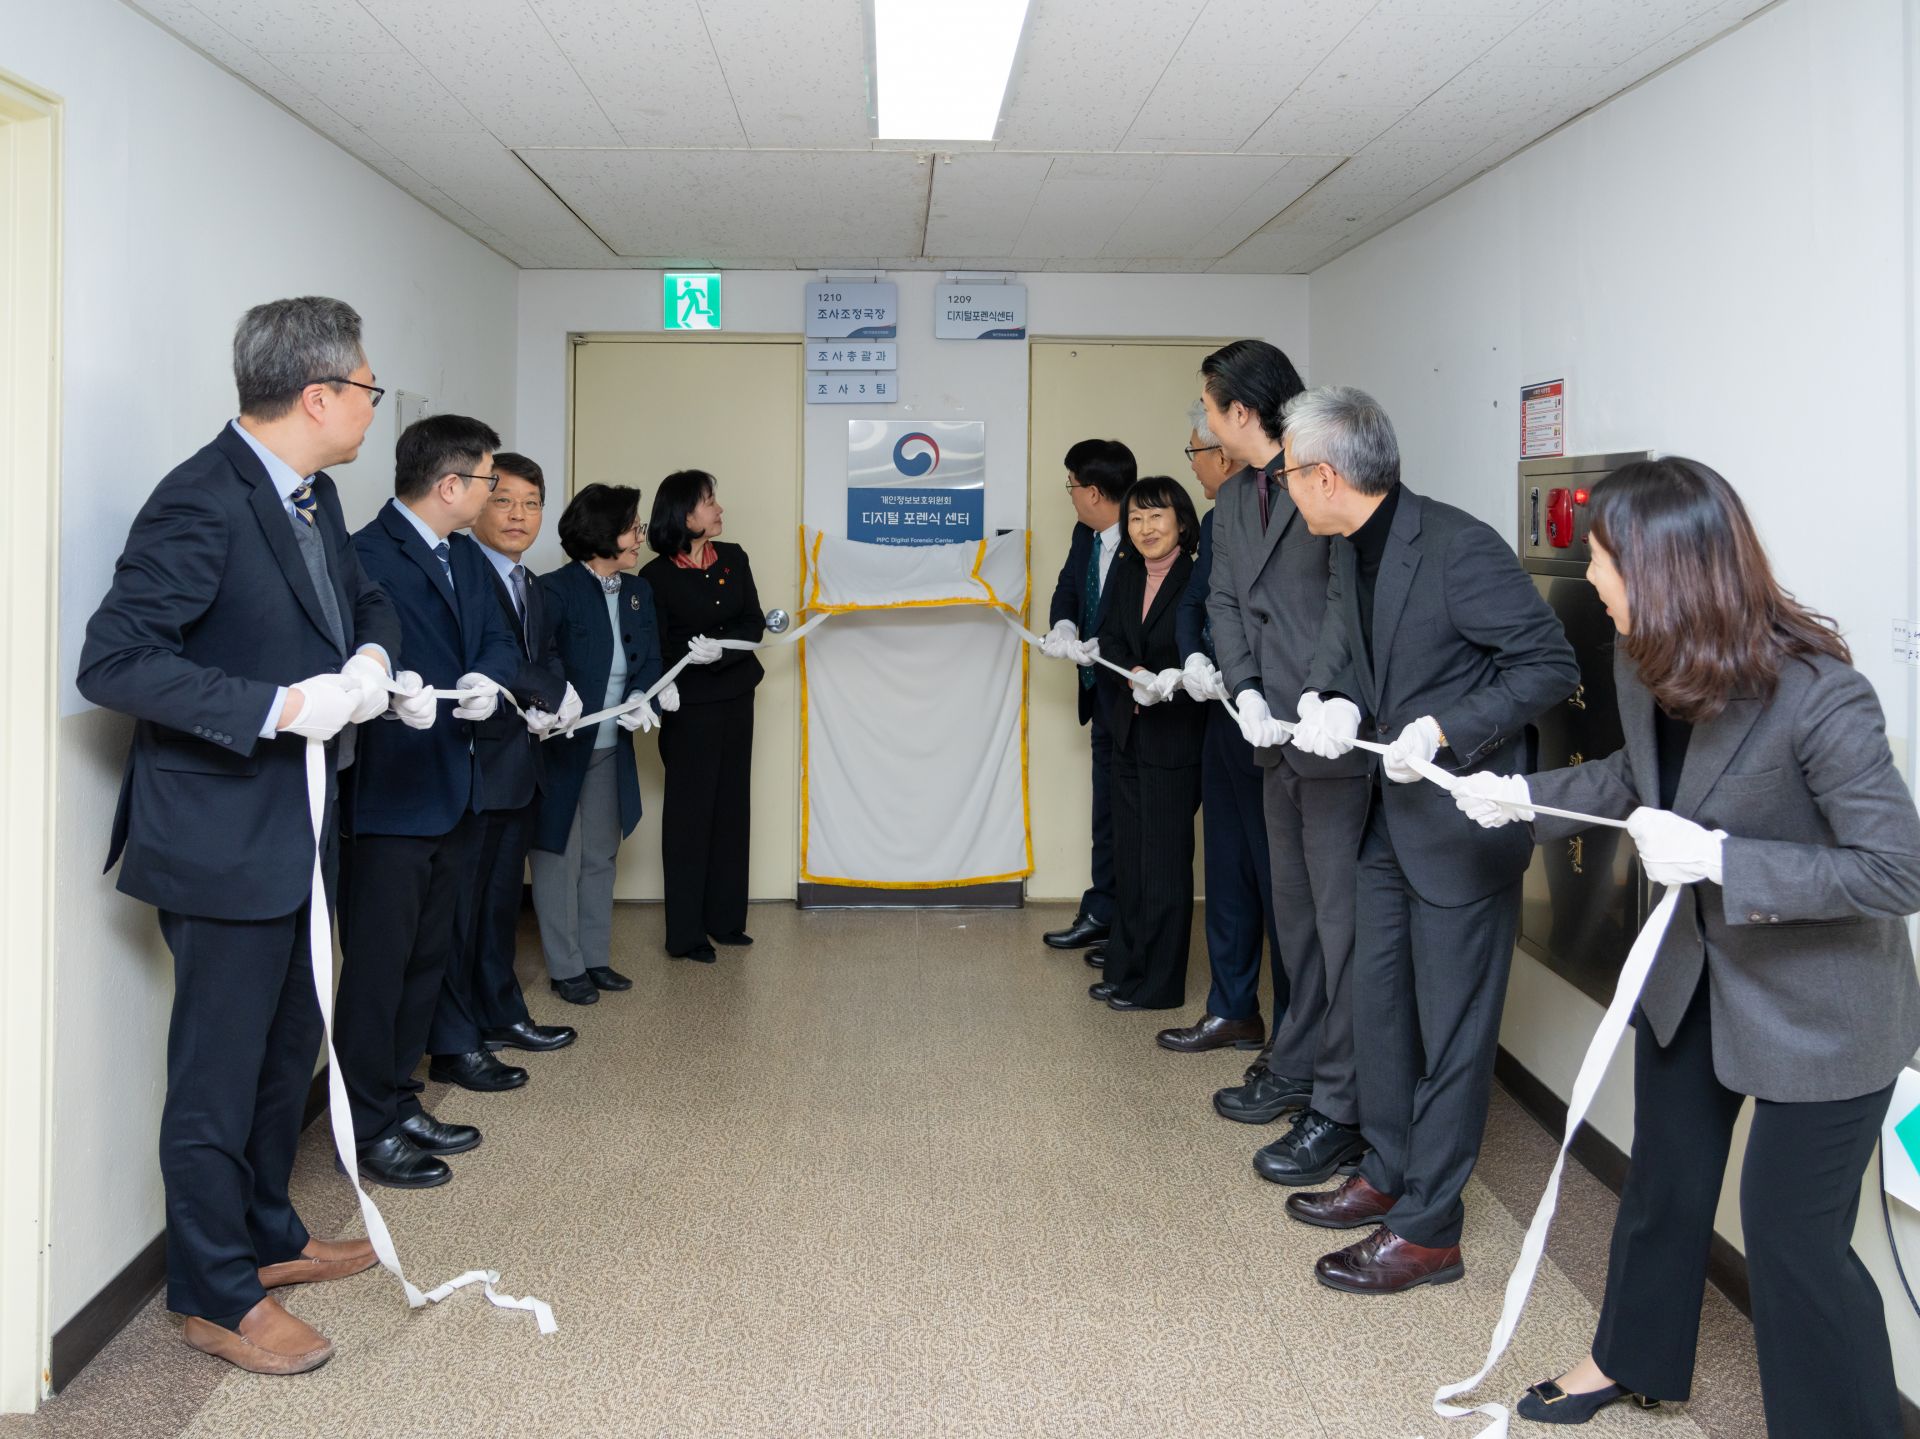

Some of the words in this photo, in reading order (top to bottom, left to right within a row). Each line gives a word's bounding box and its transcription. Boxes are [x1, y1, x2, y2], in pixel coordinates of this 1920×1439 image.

[818, 293, 842, 302] 1210
[947, 295, 972, 304] 1209
[817, 308, 886, 321] 조사조정국장
[947, 310, 1014, 322] 디지털포렌식센터
[880, 495, 952, 505] 개인정보보호위원회
[862, 511, 899, 526] 디지털
[904, 511, 941, 526] 포렌식
[945, 511, 970, 526] 센터
